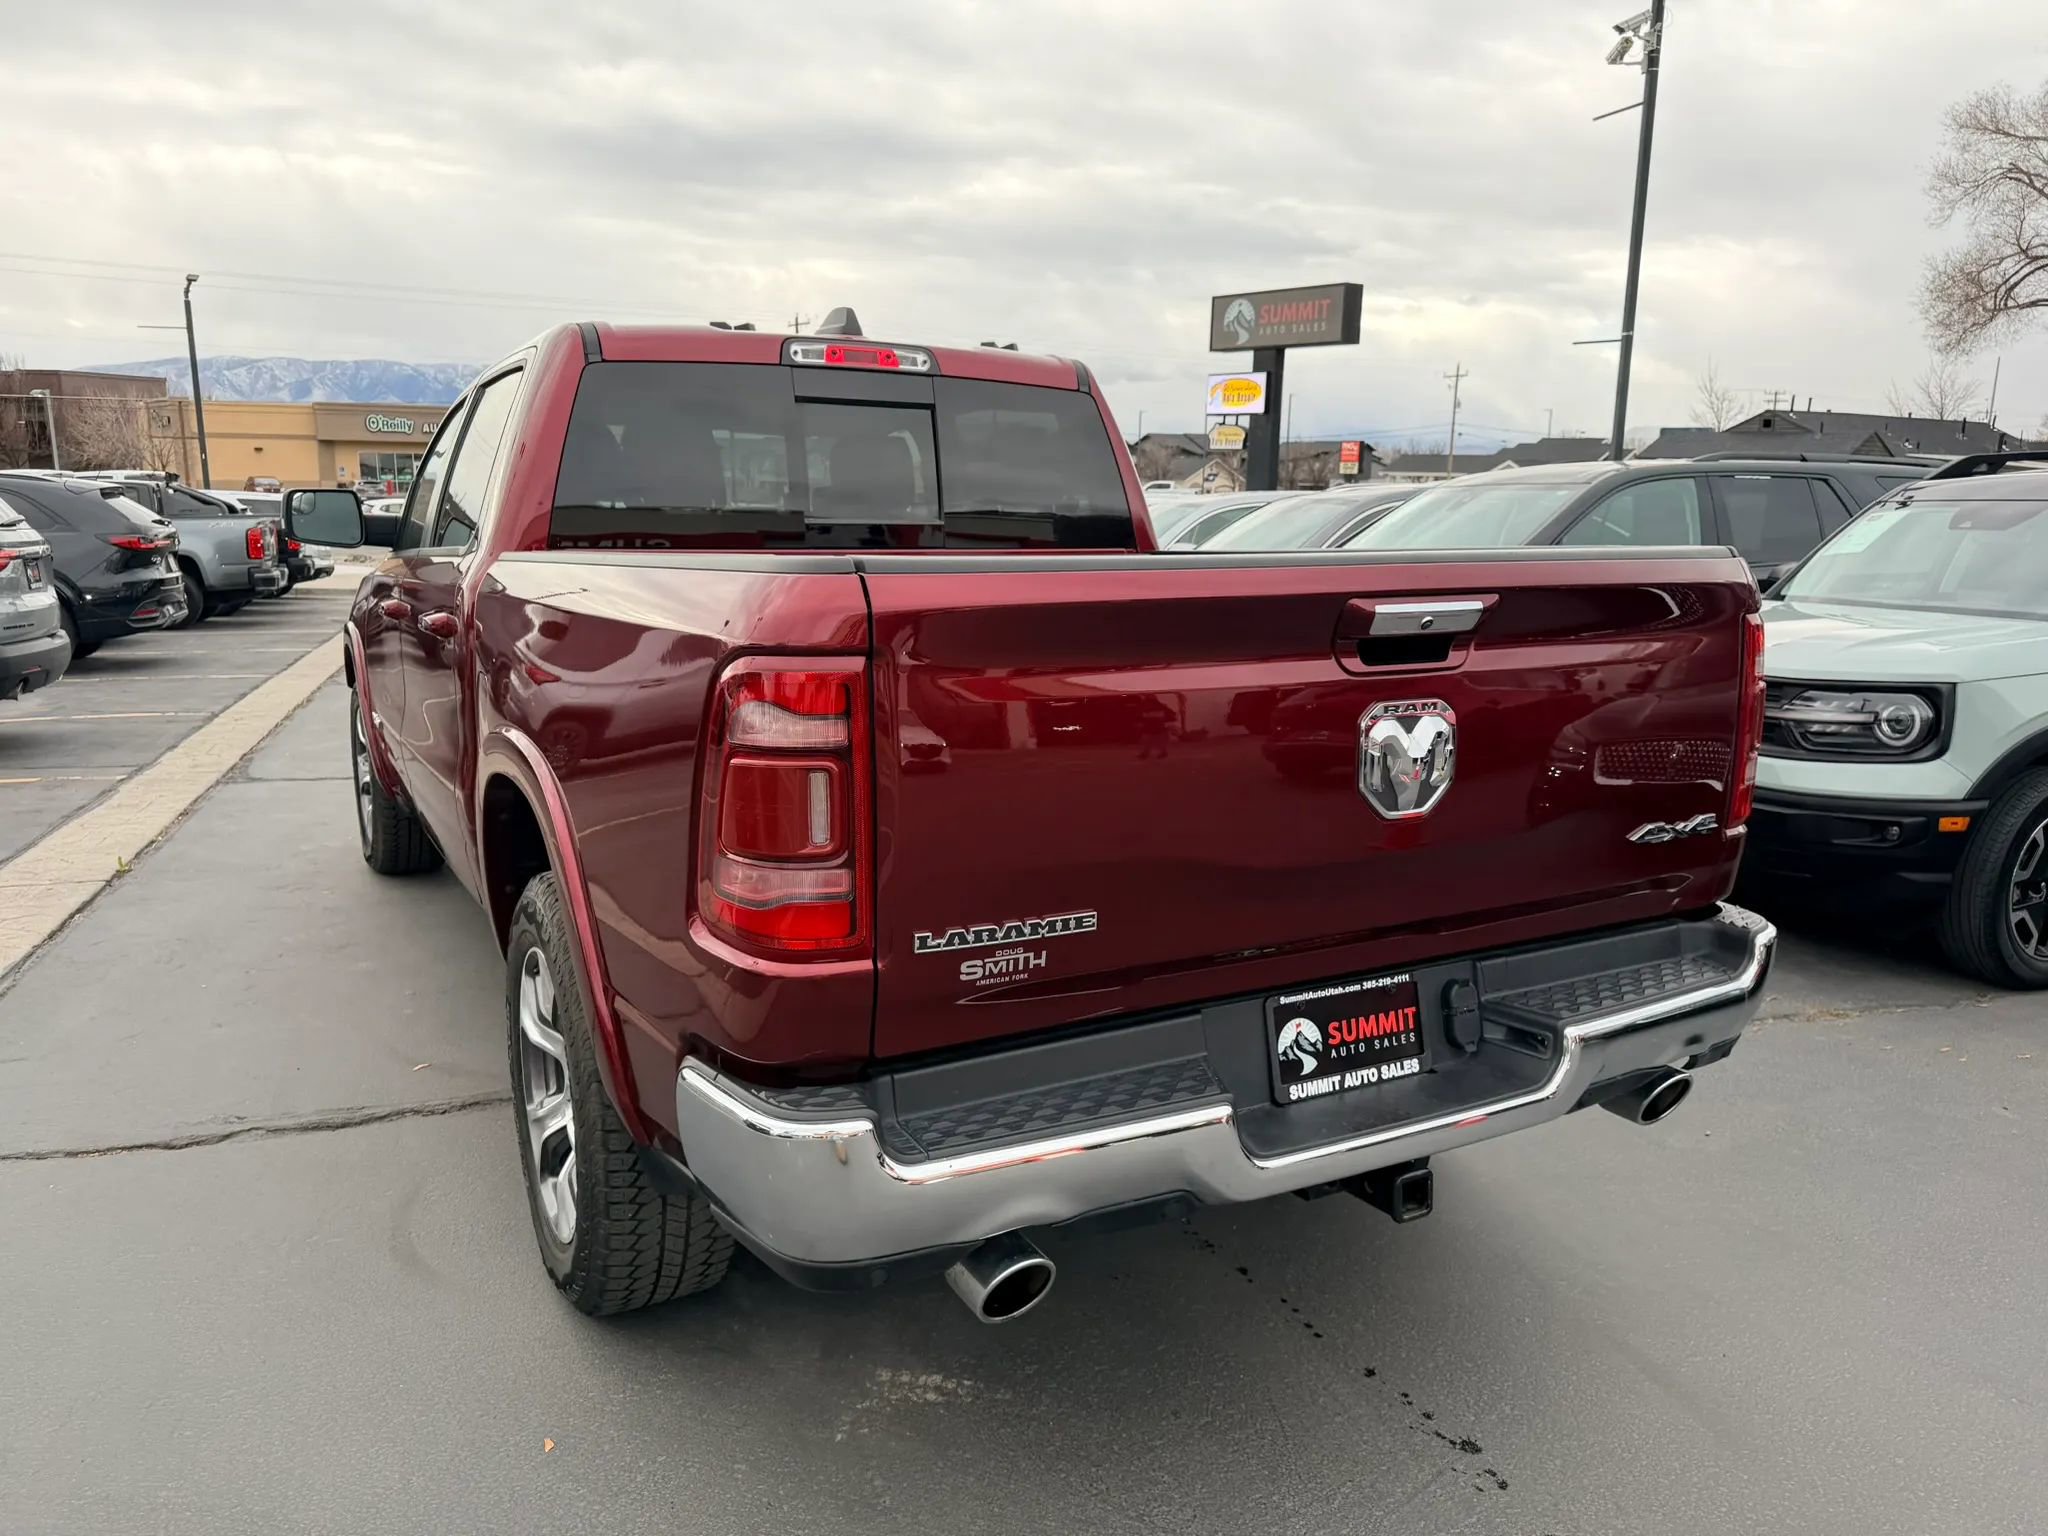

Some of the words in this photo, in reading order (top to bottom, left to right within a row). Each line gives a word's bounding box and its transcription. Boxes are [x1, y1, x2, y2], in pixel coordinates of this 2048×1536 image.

[1258, 299, 1331, 324] SUMMIT
[1259, 325, 1285, 335] AUTO
[1292, 321, 1326, 333] SALES
[366, 414, 414, 434] O'Reilly
[422, 423, 439, 433] AU
[1383, 702, 1437, 714] RAM
[914, 910, 1098, 954] LARAMIE
[995, 947, 1024, 957] DOUG
[959, 950, 1047, 981] SMITH
[975, 976, 1010, 986] AMERICAN
[1012, 972, 1029, 982] FORK
[1280, 984, 1361, 1004] SummitAutoUtah.com
[1328, 1007, 1417, 1045] SUMMIT
[1330, 1043, 1366, 1059] AUTO
[1374, 1032, 1416, 1050] SALES
[1289, 1075, 1341, 1100] SUMMIT
[1344, 1067, 1379, 1088] AUTO
[1381, 1058, 1420, 1080] SALES
